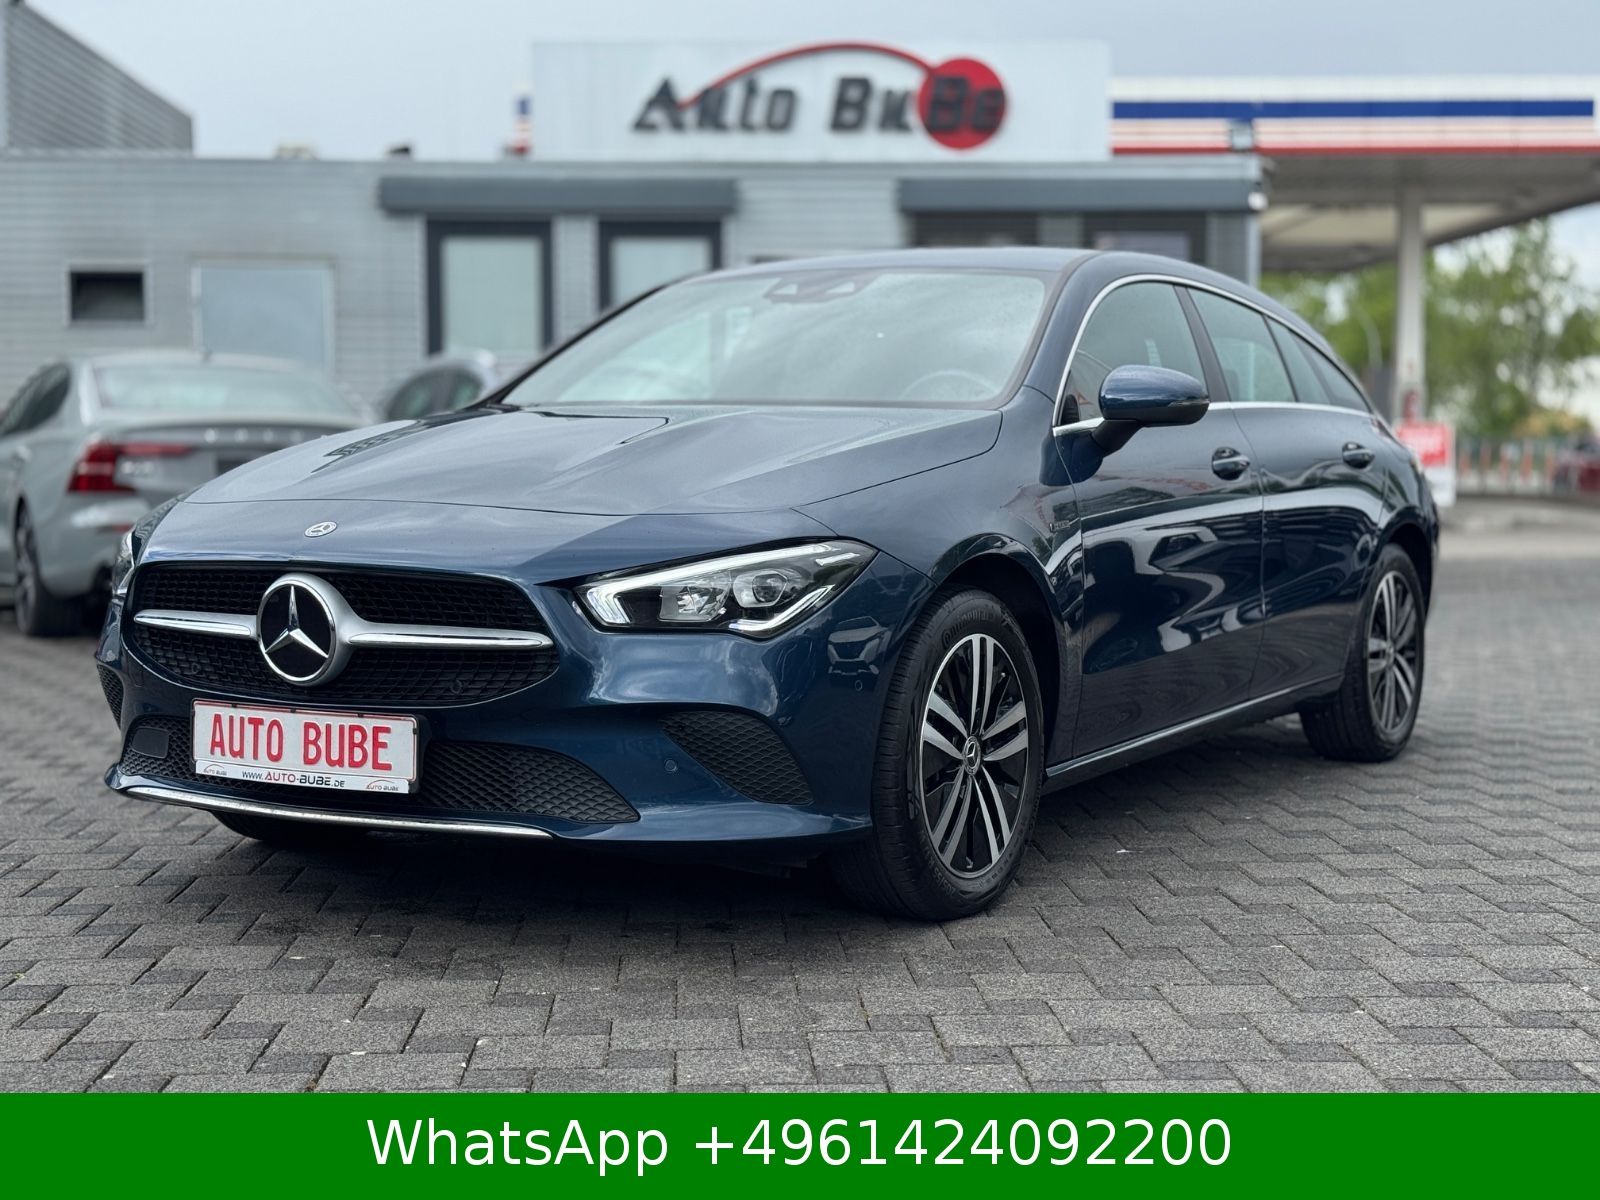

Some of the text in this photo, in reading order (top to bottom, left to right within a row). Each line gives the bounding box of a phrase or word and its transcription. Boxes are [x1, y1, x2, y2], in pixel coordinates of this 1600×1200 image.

[631, 75, 797, 132] Auto
[210, 713, 392, 771] AUTO BUBE
